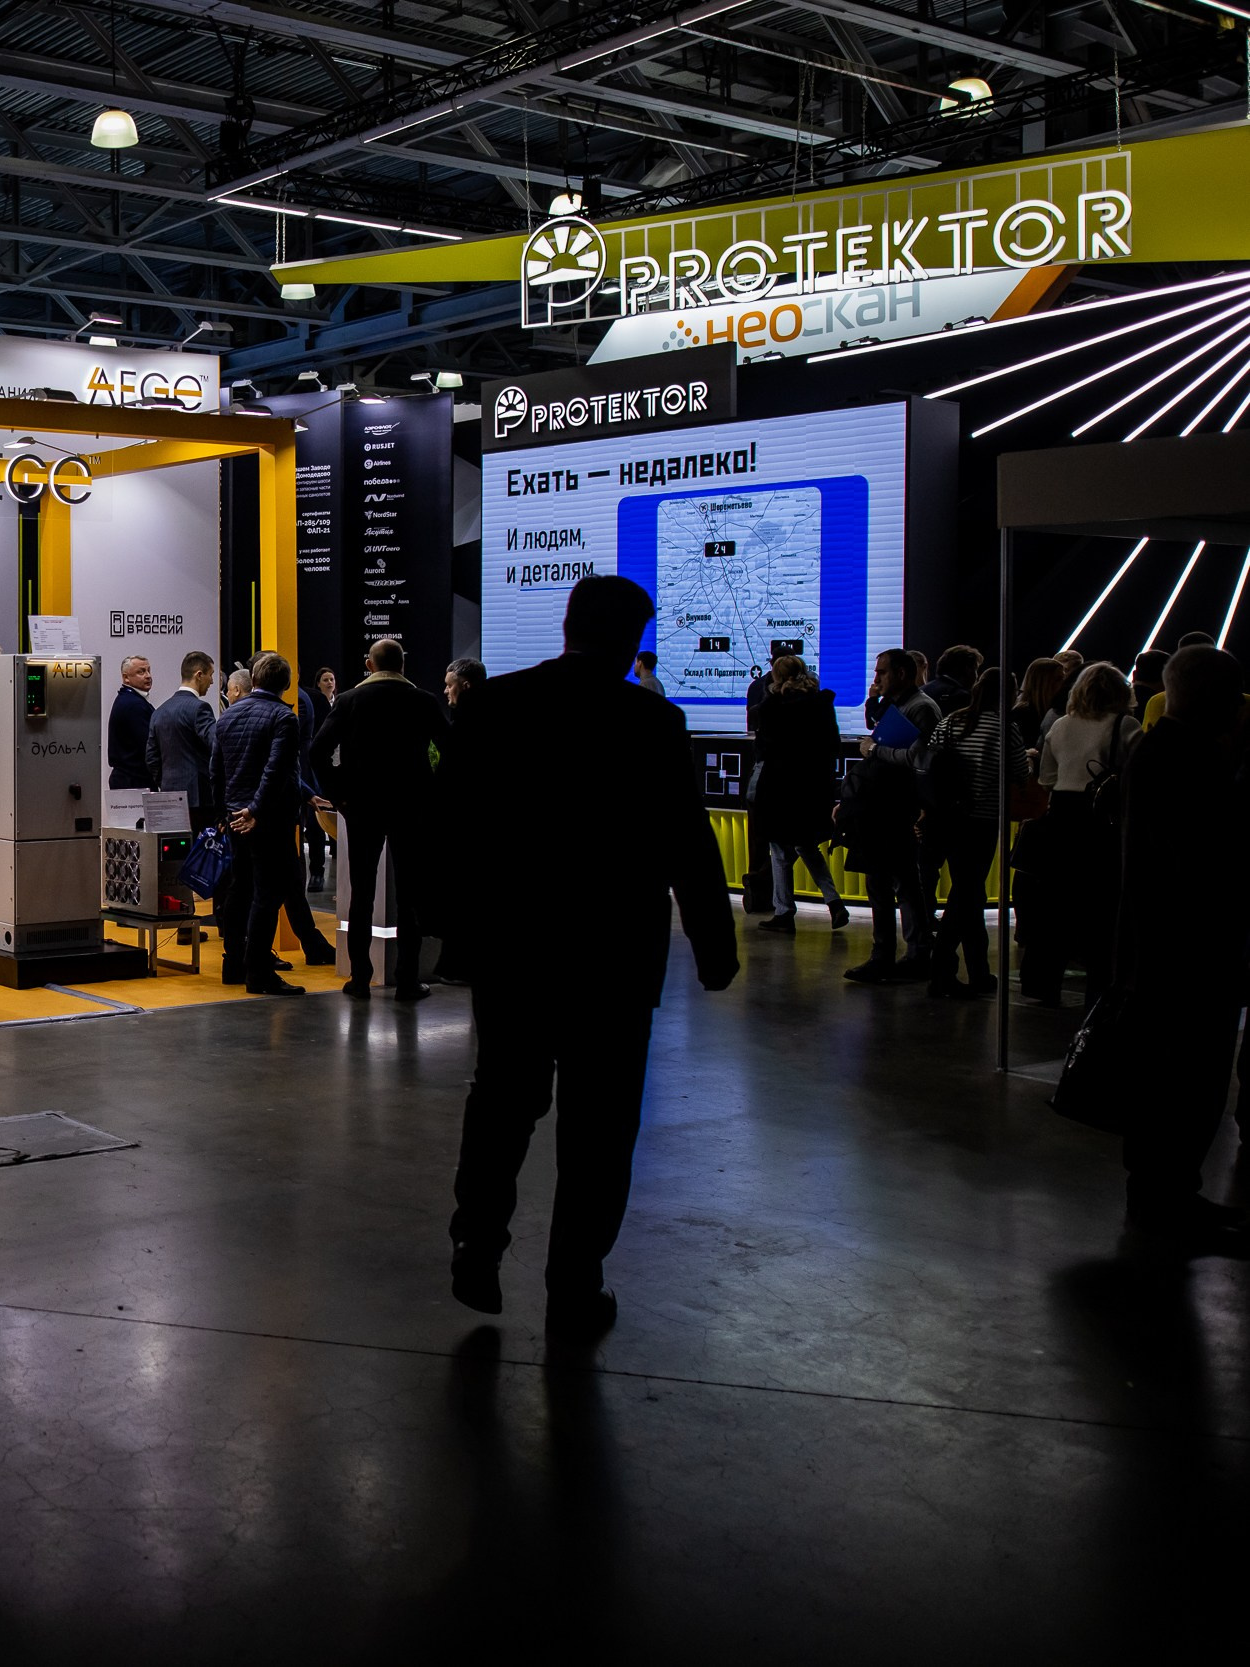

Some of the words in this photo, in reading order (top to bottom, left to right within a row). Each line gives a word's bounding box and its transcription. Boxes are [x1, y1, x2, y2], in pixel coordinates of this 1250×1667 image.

[620, 189, 1132, 317] PROTEKTOR
[532, 382, 708, 433] PROTEKTOR
[507, 468, 579, 497] Ехать
[619, 442, 757, 487] недалеко!
[710, 502, 753, 512] Шереметьево
[373, 511, 398, 519] NordStar
[507, 528, 517, 551] И
[523, 528, 586, 552] людям,
[713, 543, 720, 554] 2
[720, 545, 726, 554] ч
[506, 566, 516, 584] и
[127, 614, 183, 625] СДЕЛАНО
[685, 612, 712, 623] Внуково
[767, 617, 805, 629] Жуковский
[709, 639, 714, 650] 1
[714, 641, 720, 650] ч
[52, 662, 93, 678] АЕГЭ
[683, 669, 703, 678] Склад
[704, 669, 713, 677] ГК
[713, 668, 747, 678] Протектор
[31, 741, 87, 758] дубль-А
